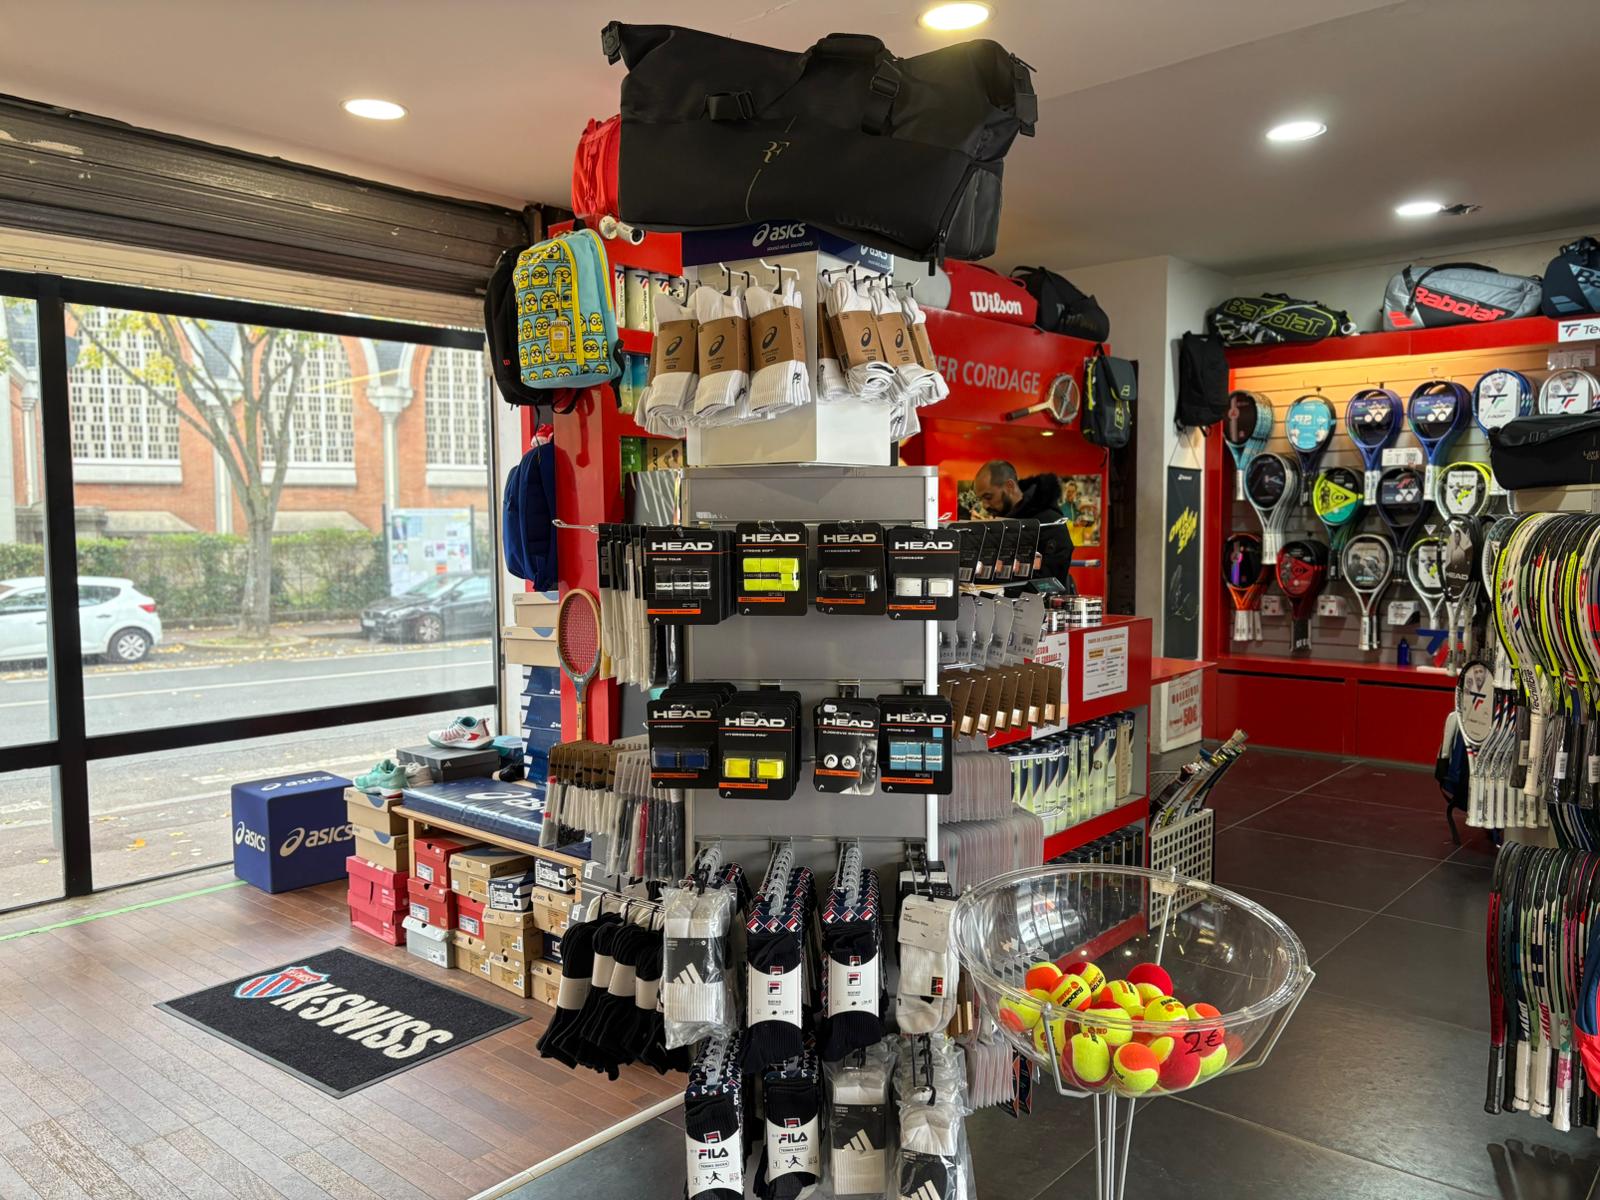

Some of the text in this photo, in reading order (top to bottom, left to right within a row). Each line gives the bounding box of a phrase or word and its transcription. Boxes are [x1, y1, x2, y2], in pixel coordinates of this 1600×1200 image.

[769, 222, 806, 241] asics
[969, 291, 1023, 315] Wilson
[1415, 285, 1506, 322] Babolat
[963, 361, 1041, 396] CORDAGE
[742, 533, 800, 543] HEAD
[823, 534, 877, 543] HEAD
[652, 541, 713, 551] HEAD
[895, 541, 953, 550] HEAD
[653, 710, 712, 719] HEAD
[886, 713, 947, 723] HEAD
[725, 717, 786, 727] HEAD
[823, 717, 874, 728] HEAD
[285, 774, 334, 788] asics
[244, 827, 266, 851] asics
[305, 824, 353, 848] asics
[778, 1131, 808, 1144] FILA
[698, 1147, 729, 1160] FILA
